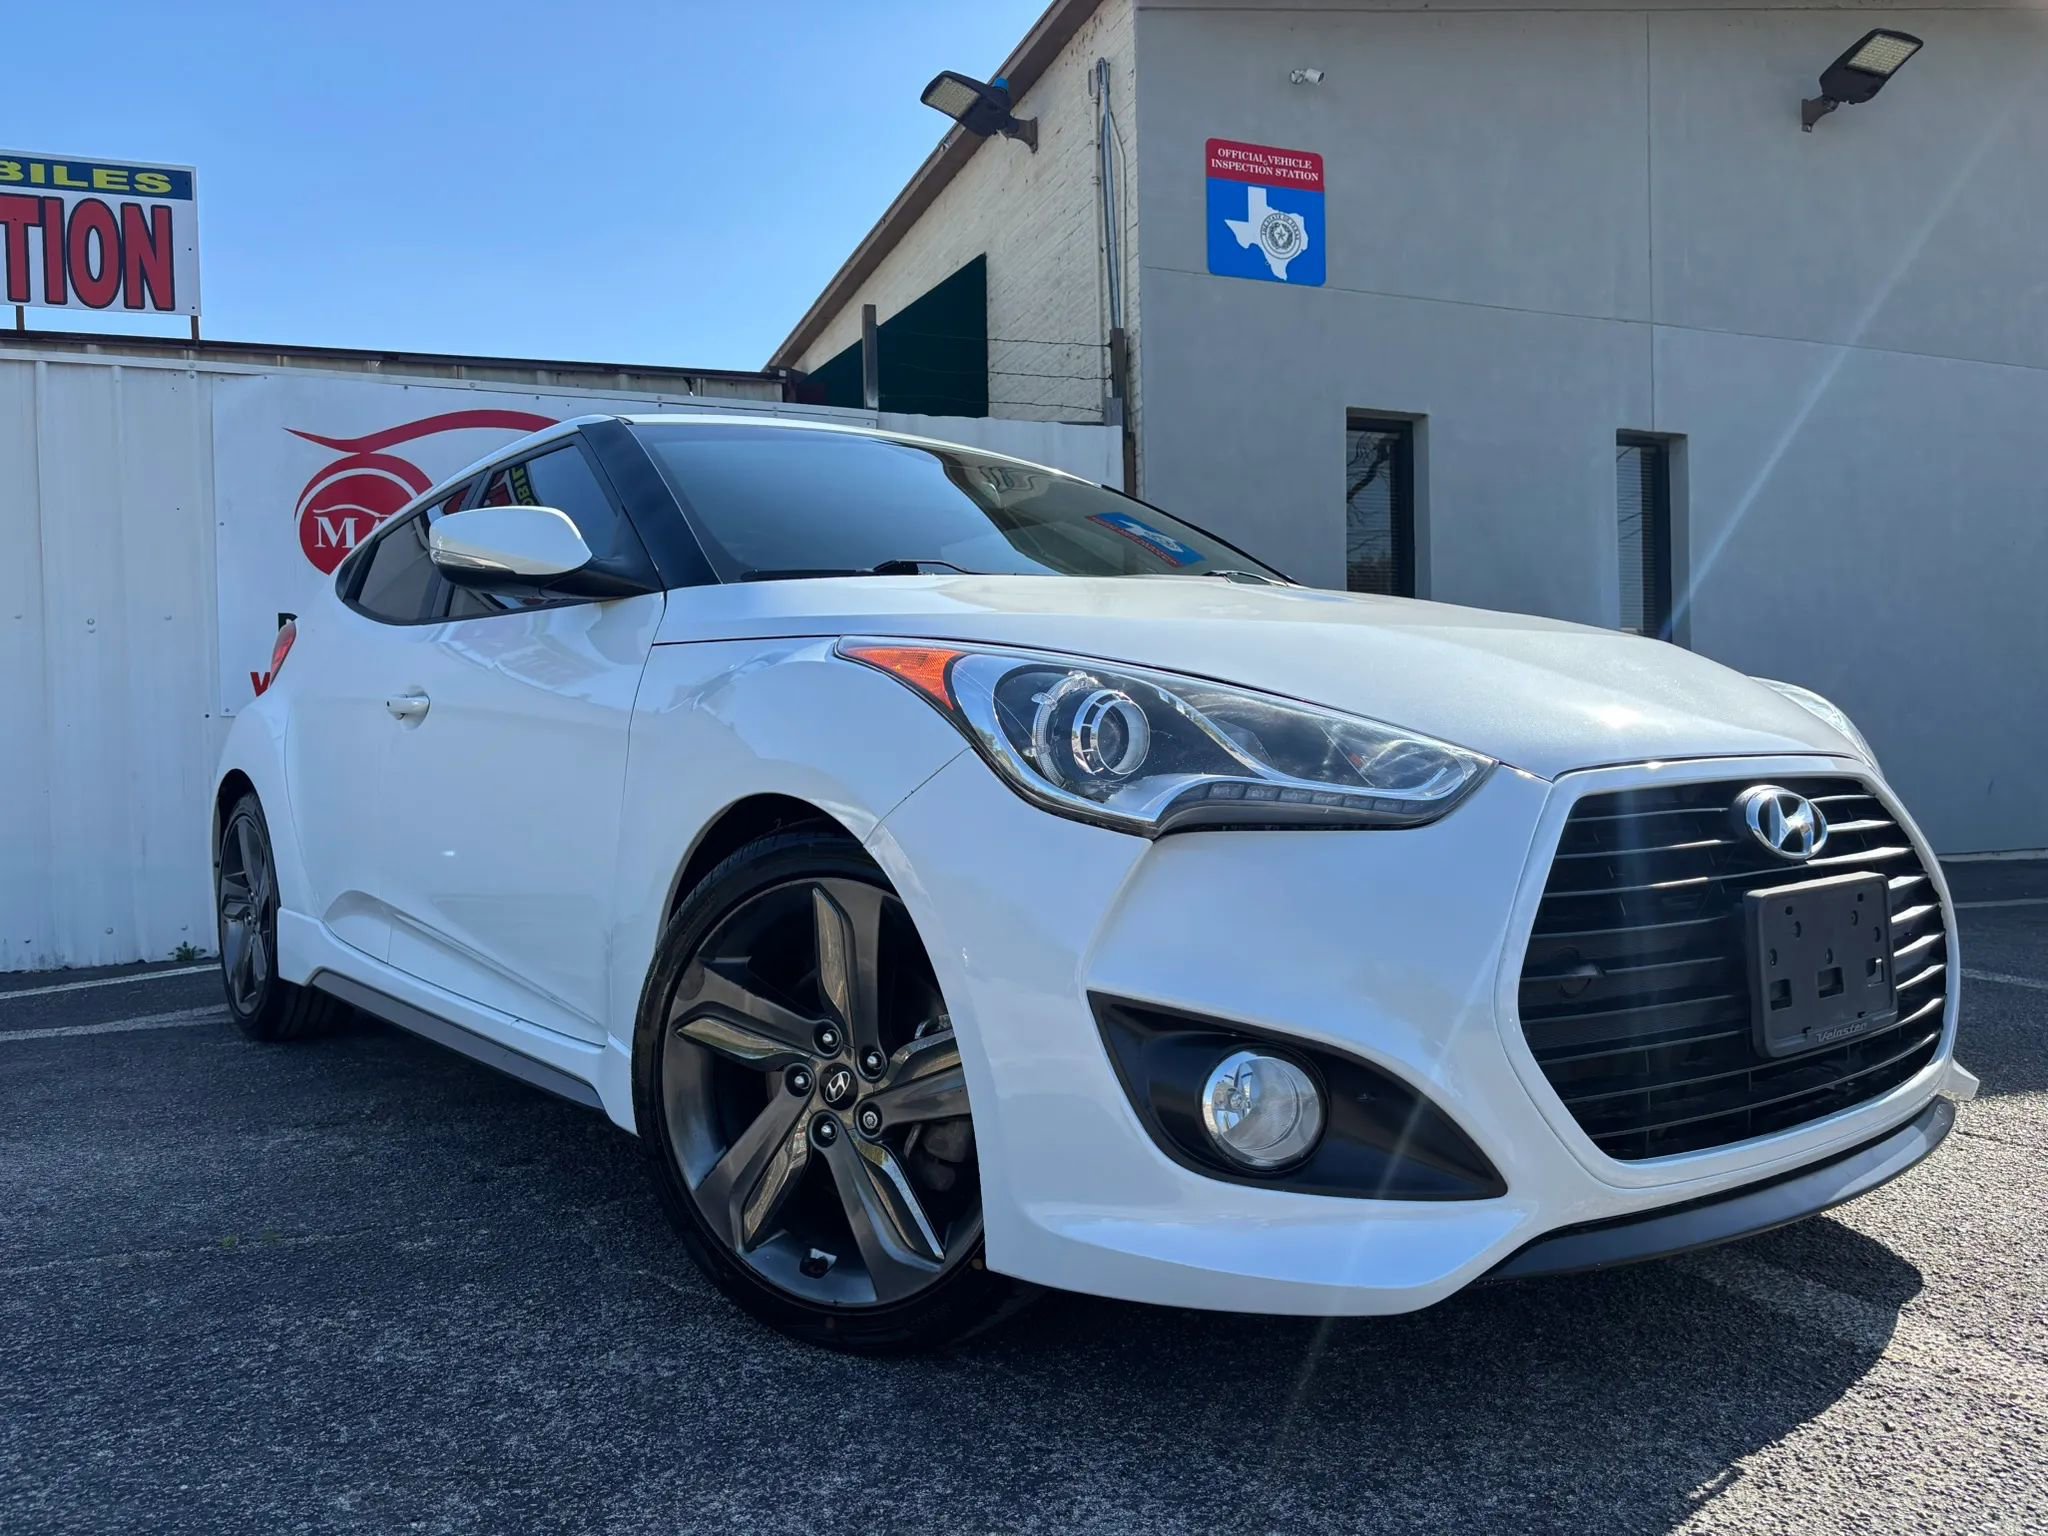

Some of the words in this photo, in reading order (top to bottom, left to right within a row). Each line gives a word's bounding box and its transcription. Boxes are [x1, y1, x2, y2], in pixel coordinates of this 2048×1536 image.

[1211, 158, 1273, 175] INSPECTION
[1275, 168, 1318, 181] STATION
[1217, 148, 1264, 162] OFFICIAL
[1267, 155, 1312, 169] VEHICLE
[0, 193, 176, 312] TION
